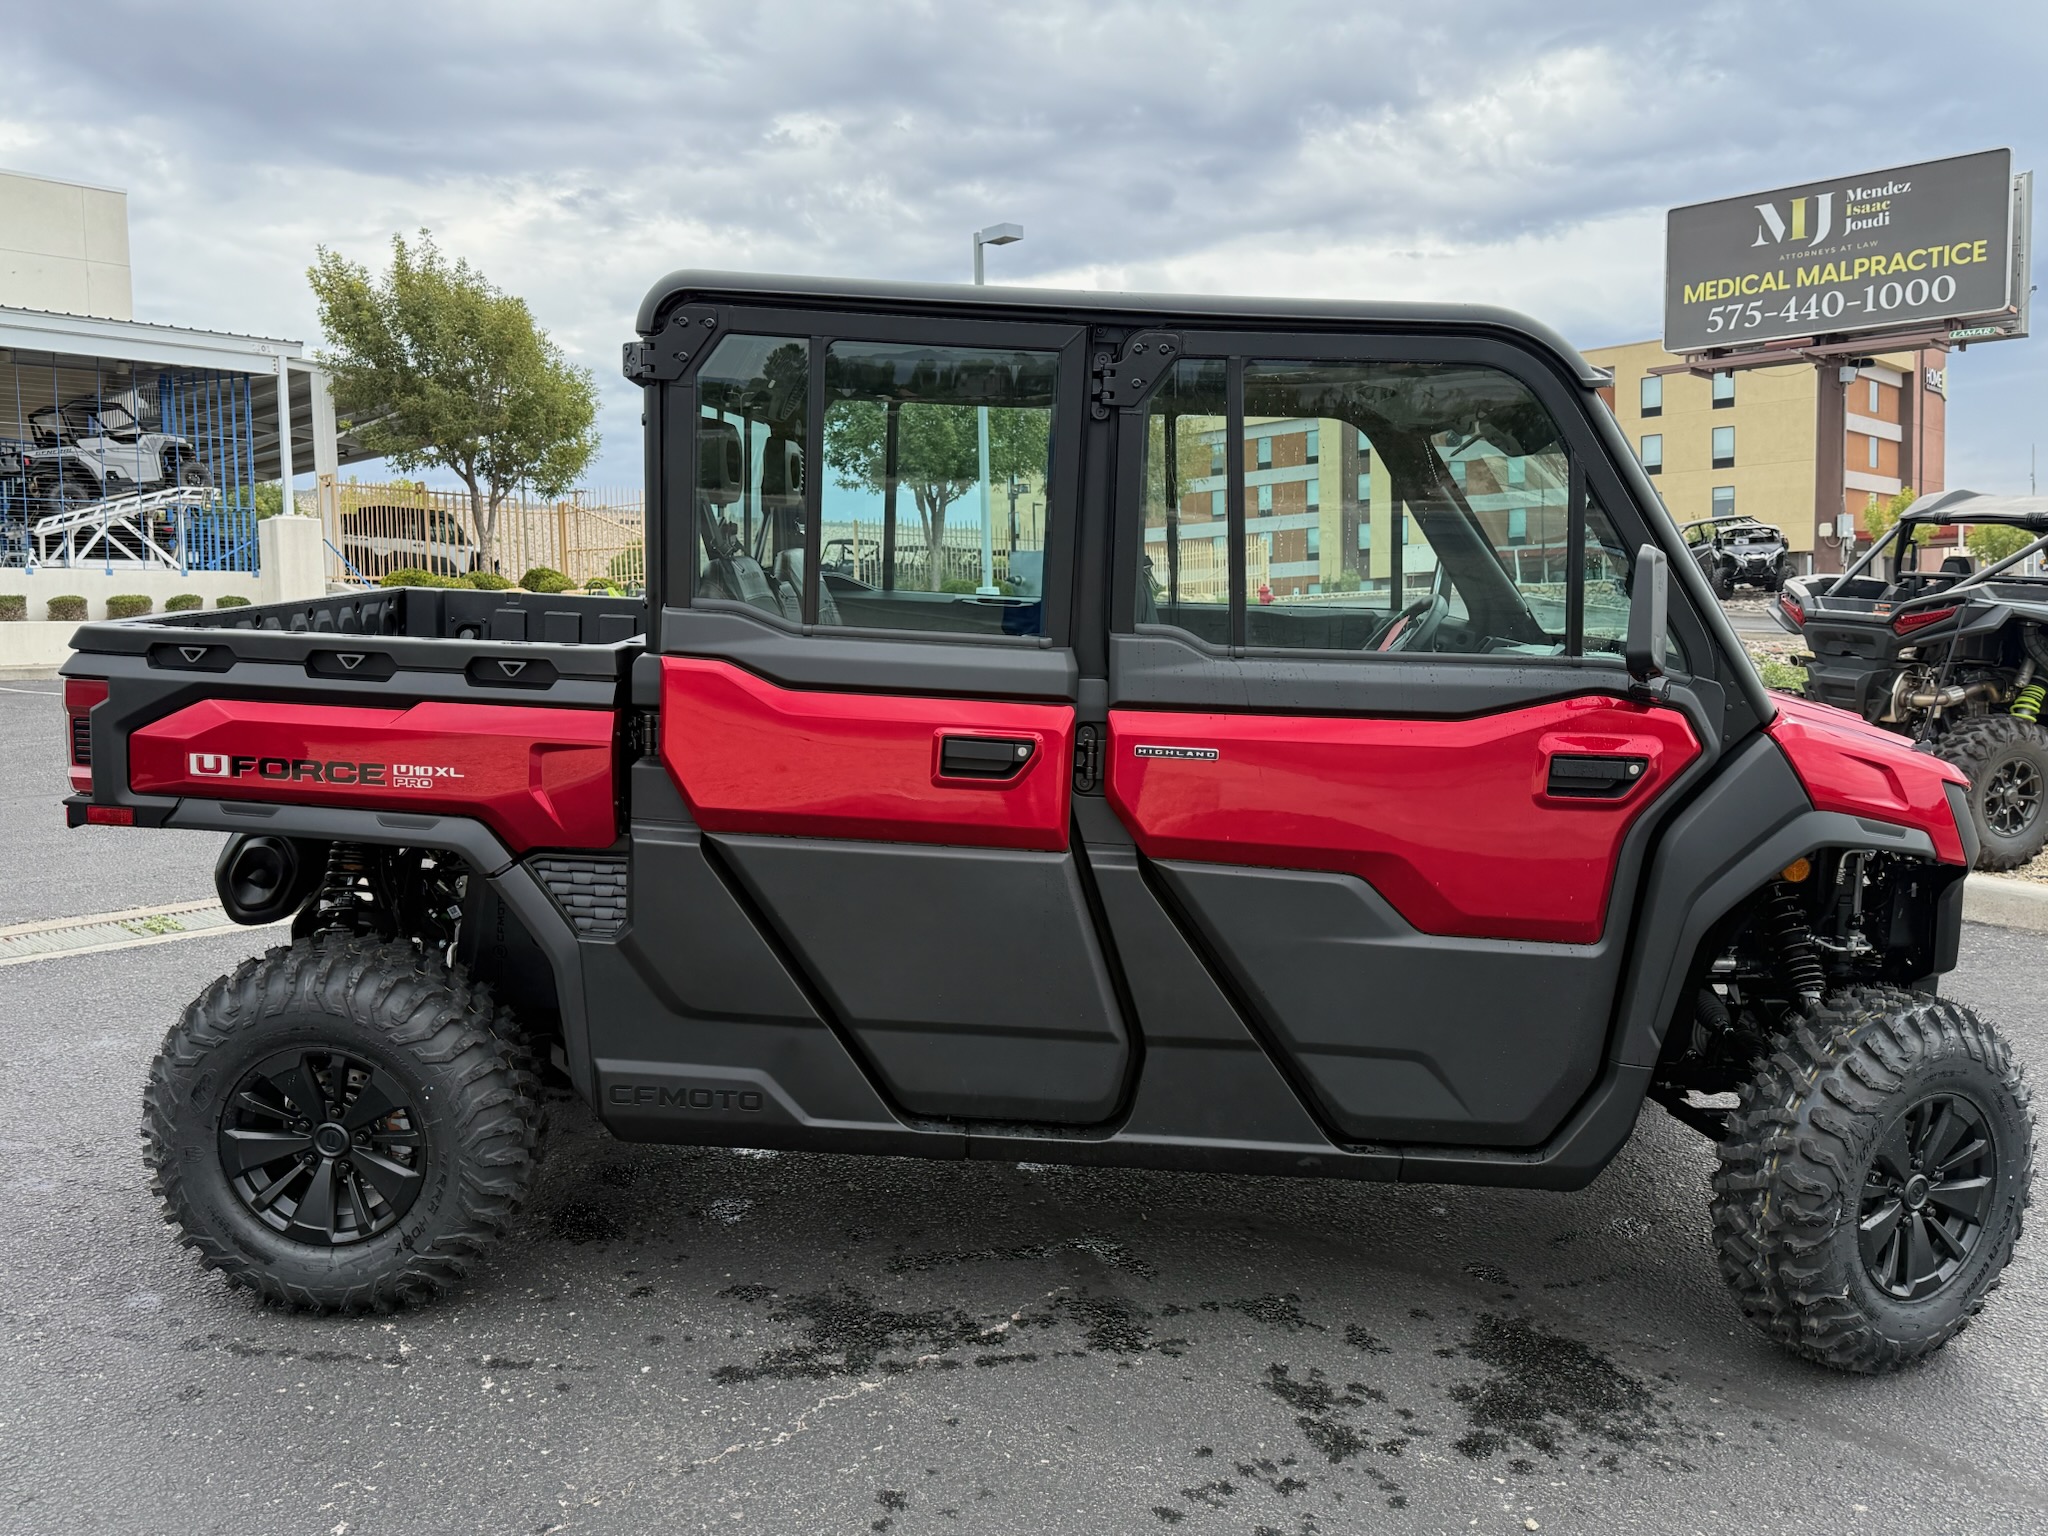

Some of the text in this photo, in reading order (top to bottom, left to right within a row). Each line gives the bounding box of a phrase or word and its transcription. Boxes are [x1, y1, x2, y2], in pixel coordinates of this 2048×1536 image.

[1846, 181, 1912, 203] Mendez
[1846, 199, 1891, 217] Isaac
[1842, 212, 1891, 237] Joudi
[1779, 240, 1879, 261] ATTORNEYS AT LAW
[1683, 239, 1988, 305] MEDICAL MALPRACTICE
[1706, 274, 1957, 333] 575-440-1000
[1952, 327, 1991, 338] LAMAR
[1138, 748, 1215, 758] HIGHLAND
[393, 777, 432, 788] PRO
[497, 895, 505, 942] CFMOT
[609, 1084, 763, 1112] CFMOTO
